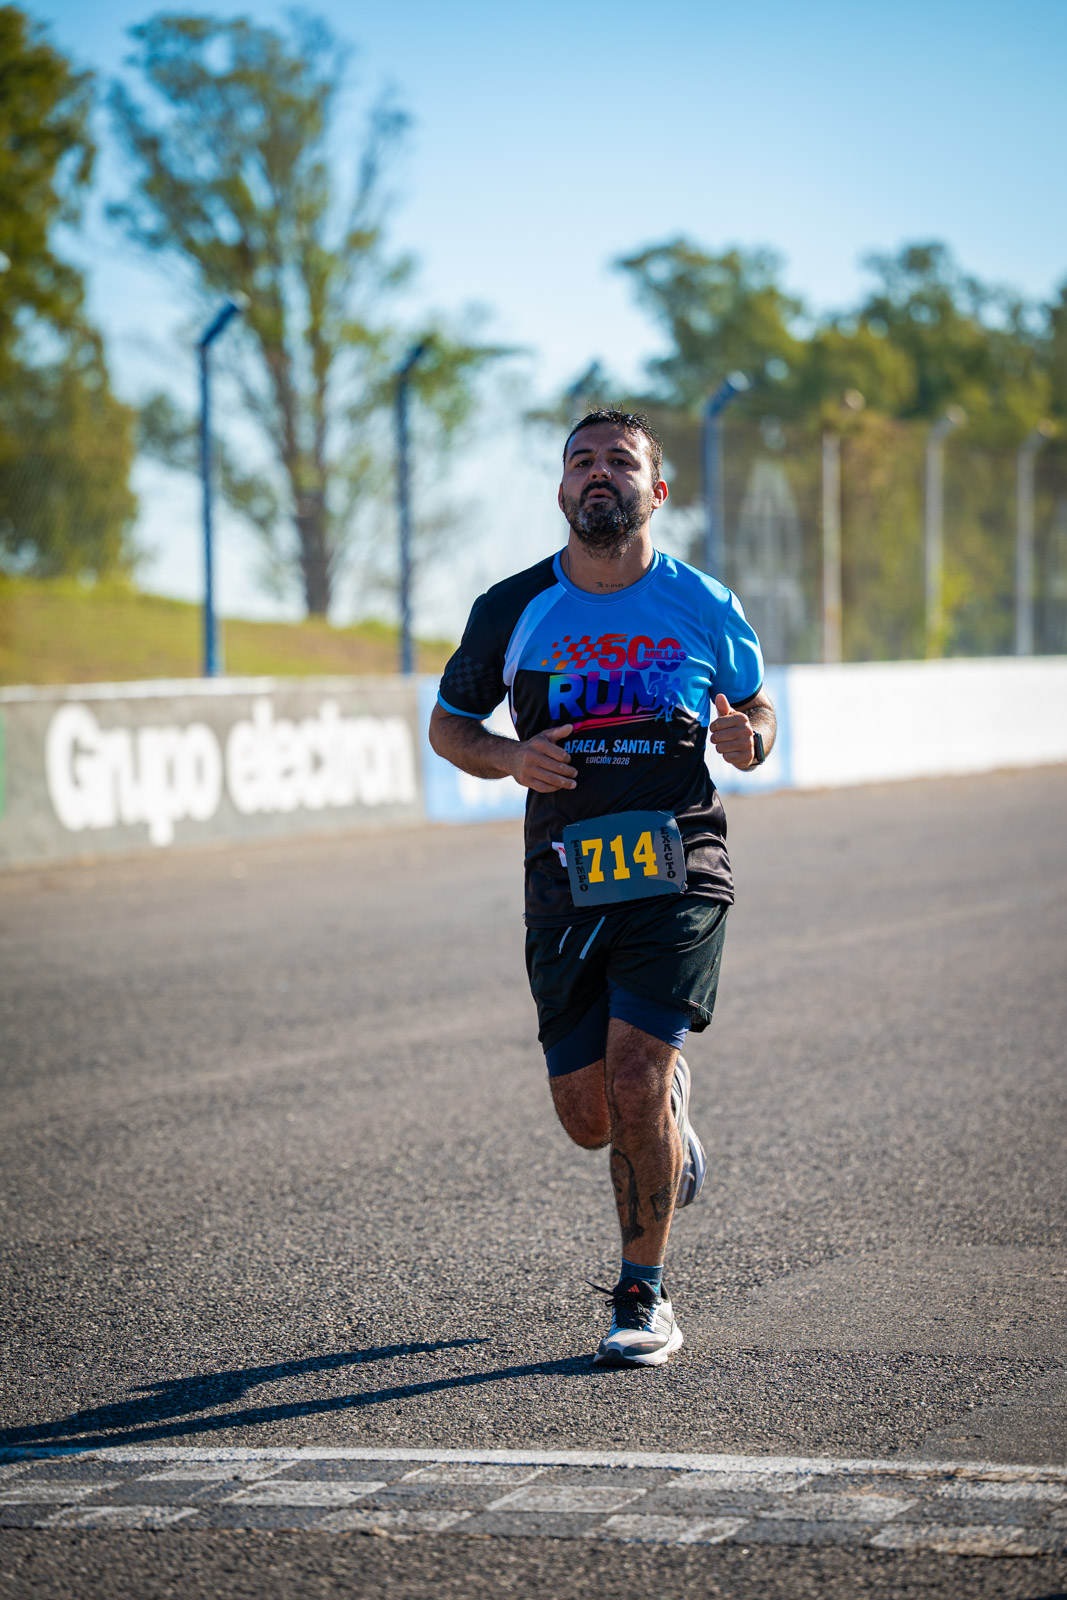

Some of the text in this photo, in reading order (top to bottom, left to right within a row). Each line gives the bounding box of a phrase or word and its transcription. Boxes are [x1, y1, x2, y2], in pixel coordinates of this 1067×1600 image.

[598, 634, 682, 672] 500
[644, 650, 687, 661] MILLAS
[548, 670, 665, 720] RUN
[564, 739, 666, 755] AFAELA, SANTA FE
[585, 755, 630, 765] EDICIÓN 2026
[45, 702, 222, 847] Grupo
[570, 839, 589, 892] TIEMPO
[581, 831, 659, 883] 714
[660, 826, 676, 879] EXACTO
